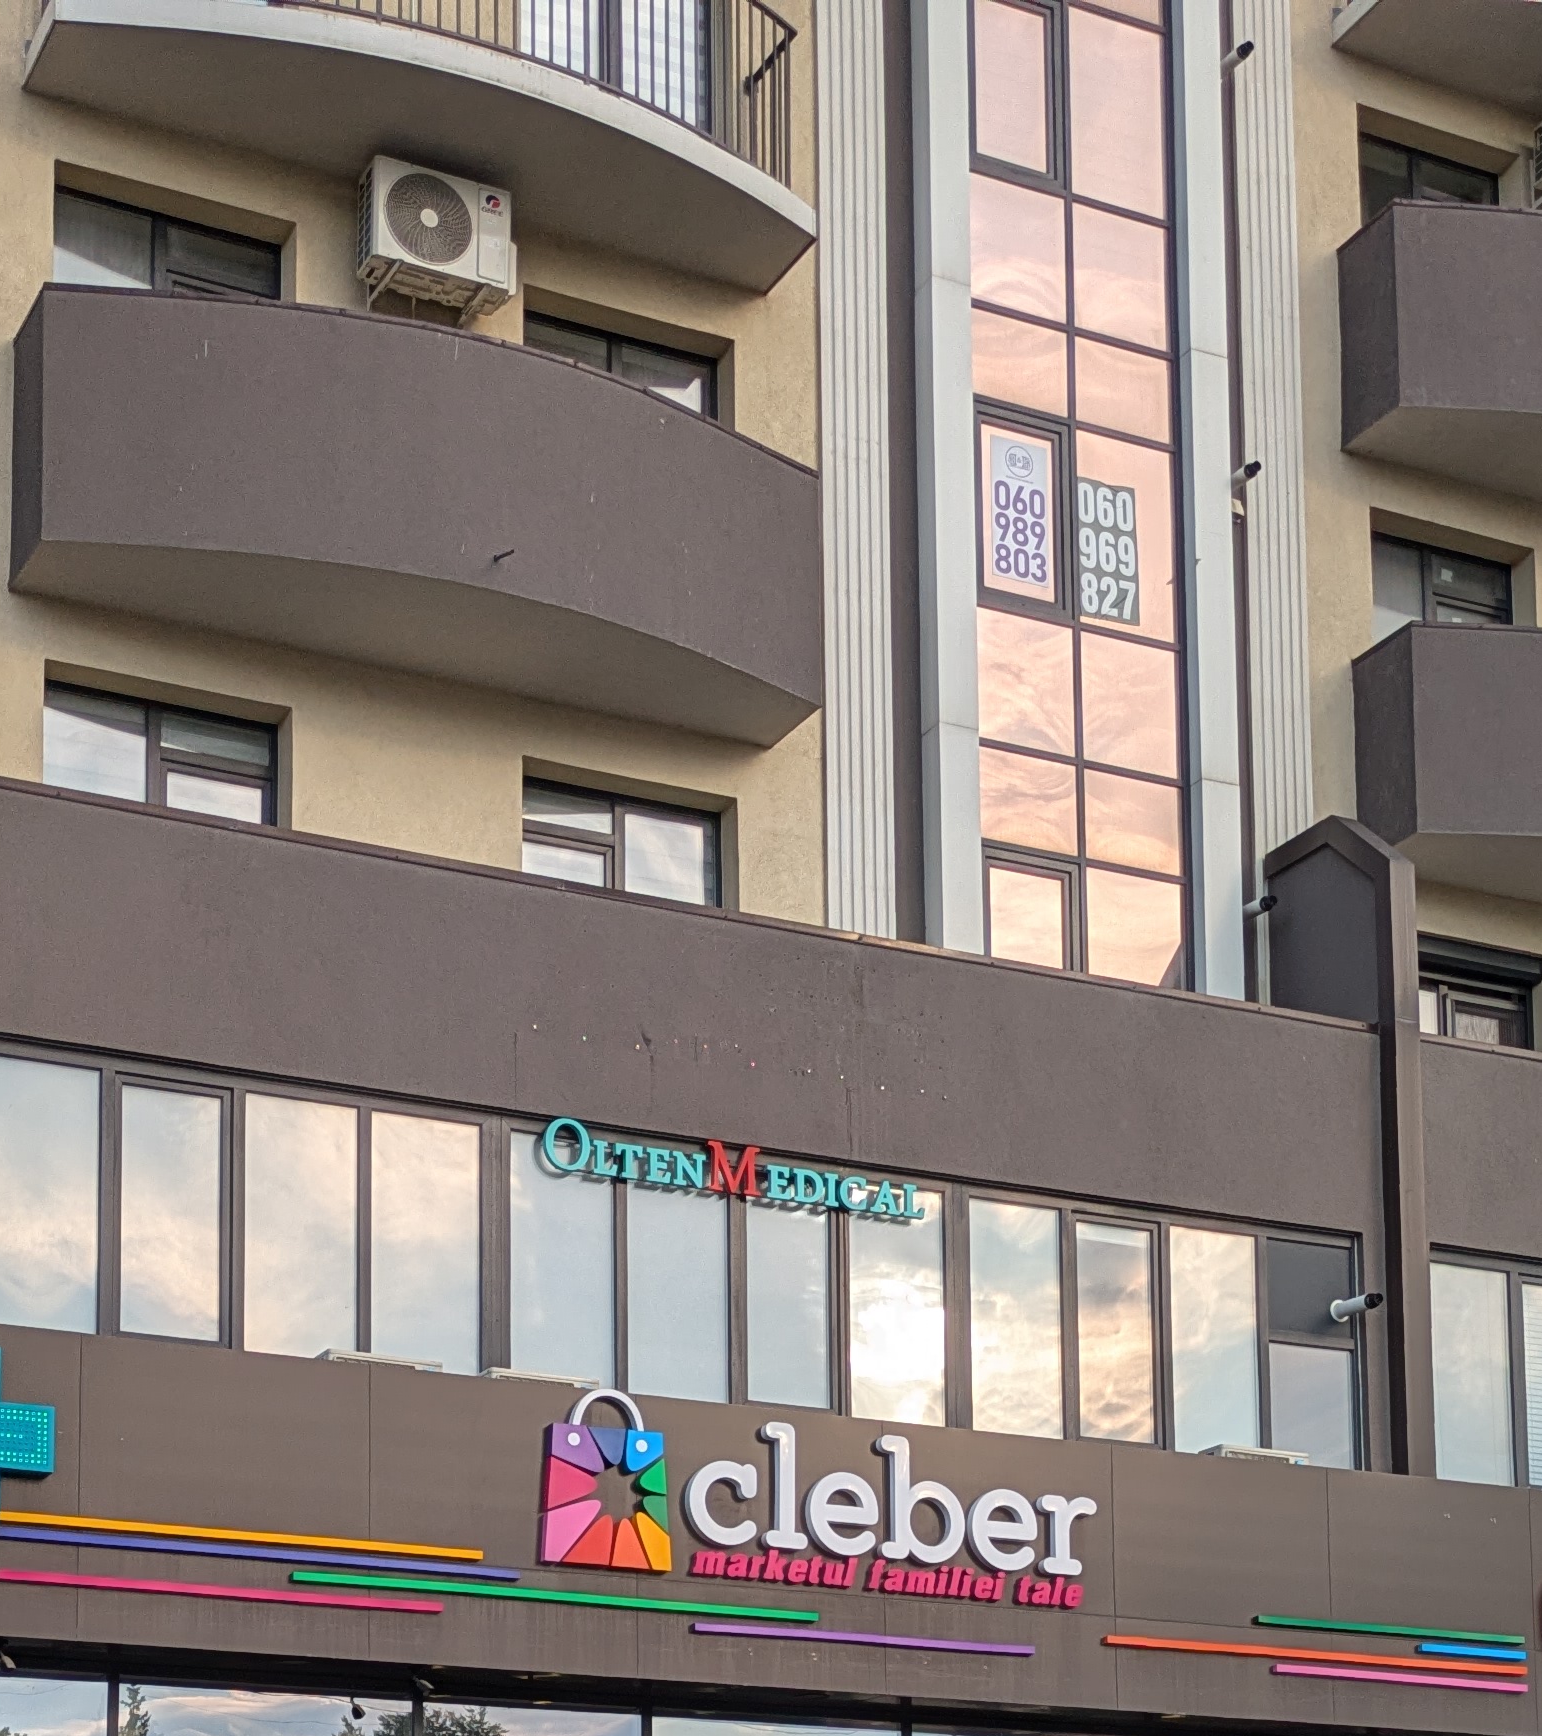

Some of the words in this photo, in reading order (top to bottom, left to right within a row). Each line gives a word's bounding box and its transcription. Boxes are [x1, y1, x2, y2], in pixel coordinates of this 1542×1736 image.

[994, 480, 1045, 520] 060
[1077, 482, 1134, 532] 060
[994, 511, 1046, 551] 989
[1079, 527, 1135, 577] 969
[995, 543, 1047, 583] 803
[1080, 573, 1136, 620] 827
[686, 1423, 1096, 1577] cleber
[690, 1548, 857, 1589] marketul
[869, 1557, 1006, 1603] familiei
[1018, 1574, 1084, 1607] tale
